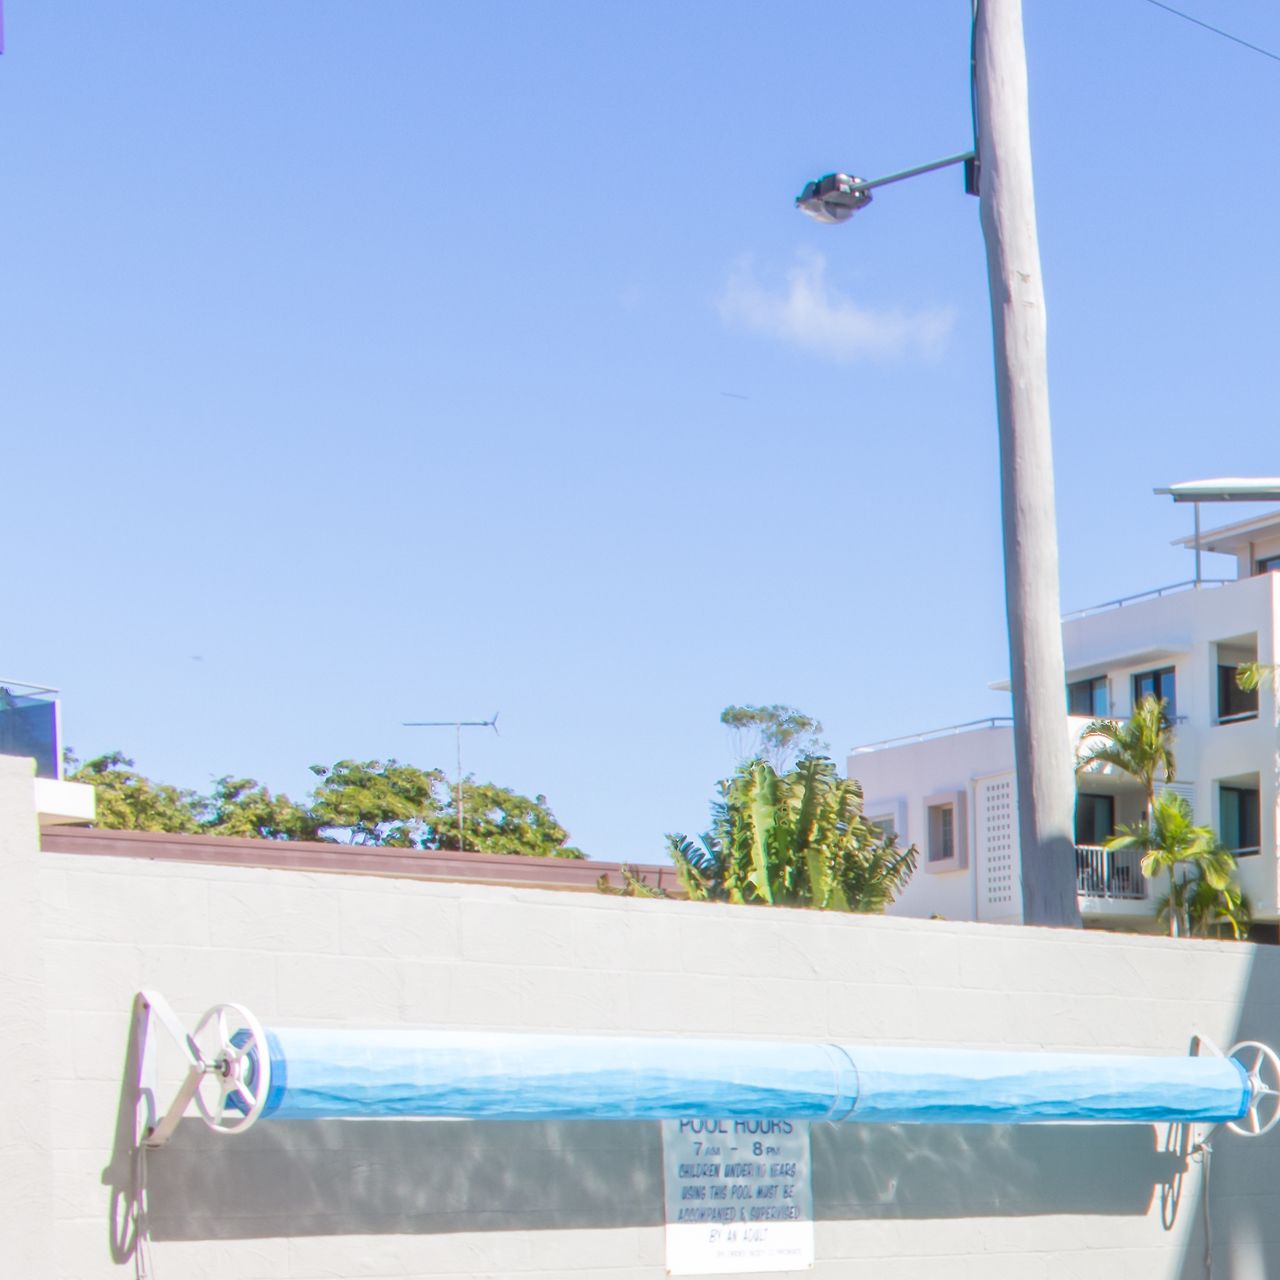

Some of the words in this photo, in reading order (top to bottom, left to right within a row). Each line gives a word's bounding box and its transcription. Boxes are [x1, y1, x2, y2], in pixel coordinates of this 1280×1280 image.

[680, 1119, 727, 1134] POOL
[735, 1119, 793, 1134] HOURS
[679, 1163, 720, 1178] CHILDREN
[724, 1163, 752, 1178] UNDER
[770, 1163, 797, 1177] YEARS
[682, 1185, 706, 1200] USING
[710, 1185, 727, 1200] THIS
[731, 1184, 752, 1199] POOL
[756, 1184, 779, 1199] MUST
[678, 1207, 736, 1221] ACCOMPANIED
[750, 1205, 800, 1220] SUPERVISED
